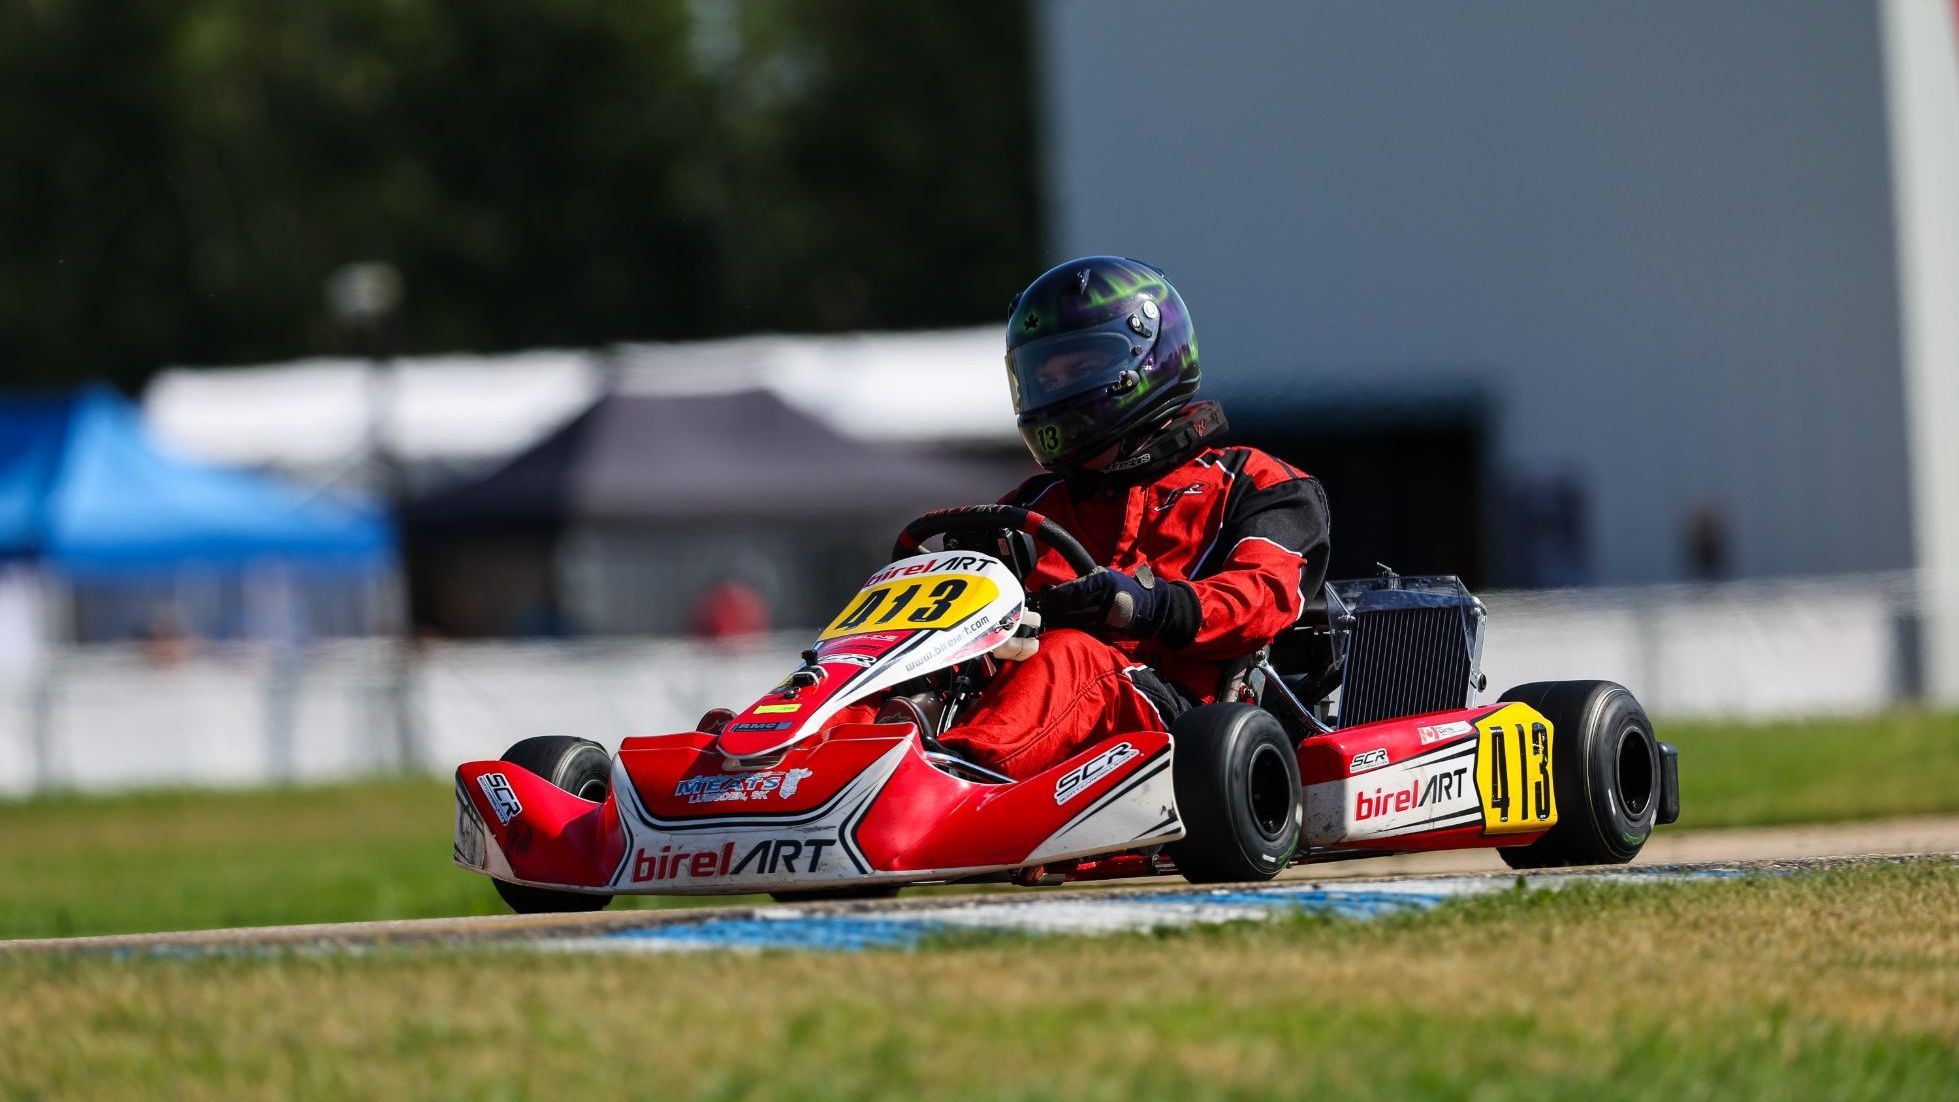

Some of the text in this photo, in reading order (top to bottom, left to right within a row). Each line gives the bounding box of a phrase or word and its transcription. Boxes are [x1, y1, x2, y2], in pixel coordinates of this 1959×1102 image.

[1037, 426, 1058, 450] 13
[834, 578, 968, 631] 413
[1057, 743, 1132, 796] SCR
[1351, 749, 1386, 768] SCR
[1489, 721, 1551, 822] 413
[485, 774, 521, 816] SCR
[674, 776, 782, 796] MEATS
